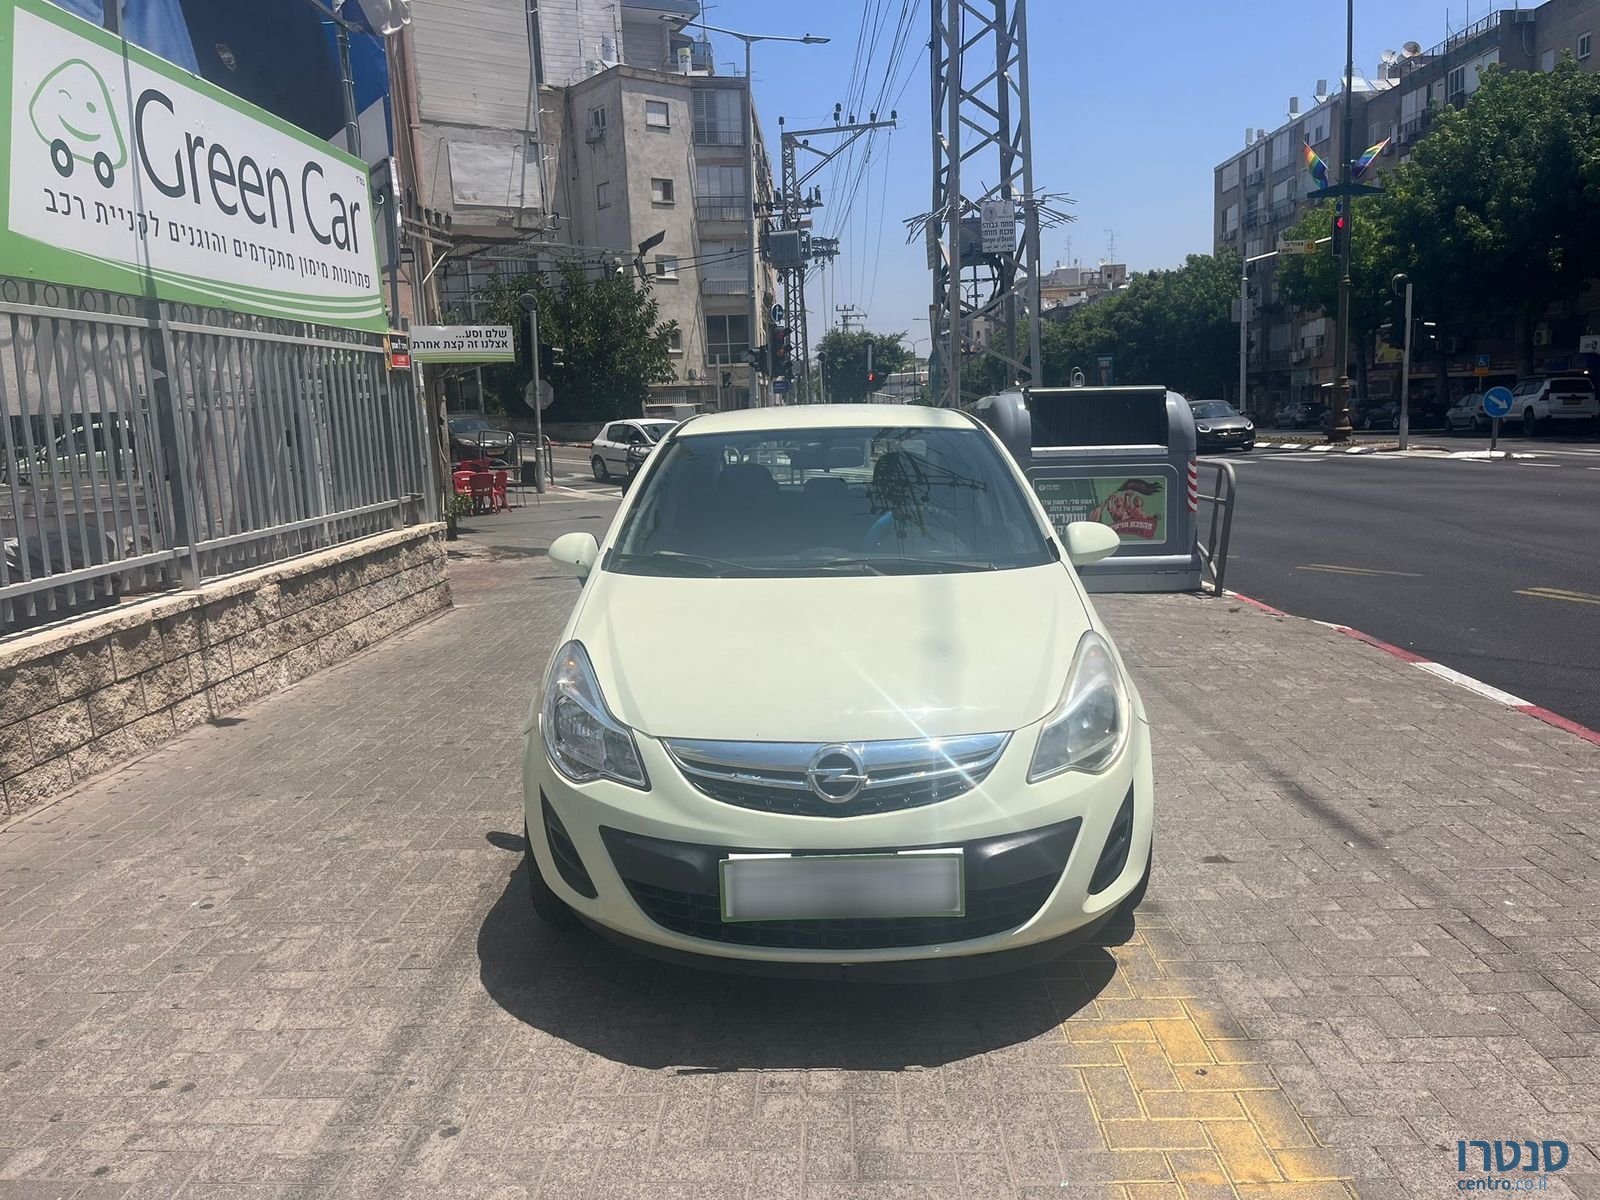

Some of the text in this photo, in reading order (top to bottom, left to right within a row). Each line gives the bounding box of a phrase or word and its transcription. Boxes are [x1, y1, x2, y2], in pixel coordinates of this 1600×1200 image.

[135, 89, 360, 254] Green Car
[44, 188, 371, 289] פתרונות מימון מתקדמים והוגנים לקניית רכב
[455, 329, 507, 338] שלם וסע...
[413, 341, 441, 349] אחרת
[443, 341, 464, 350] קצת
[467, 341, 478, 349] זה
[481, 339, 508, 349] אצלנו
